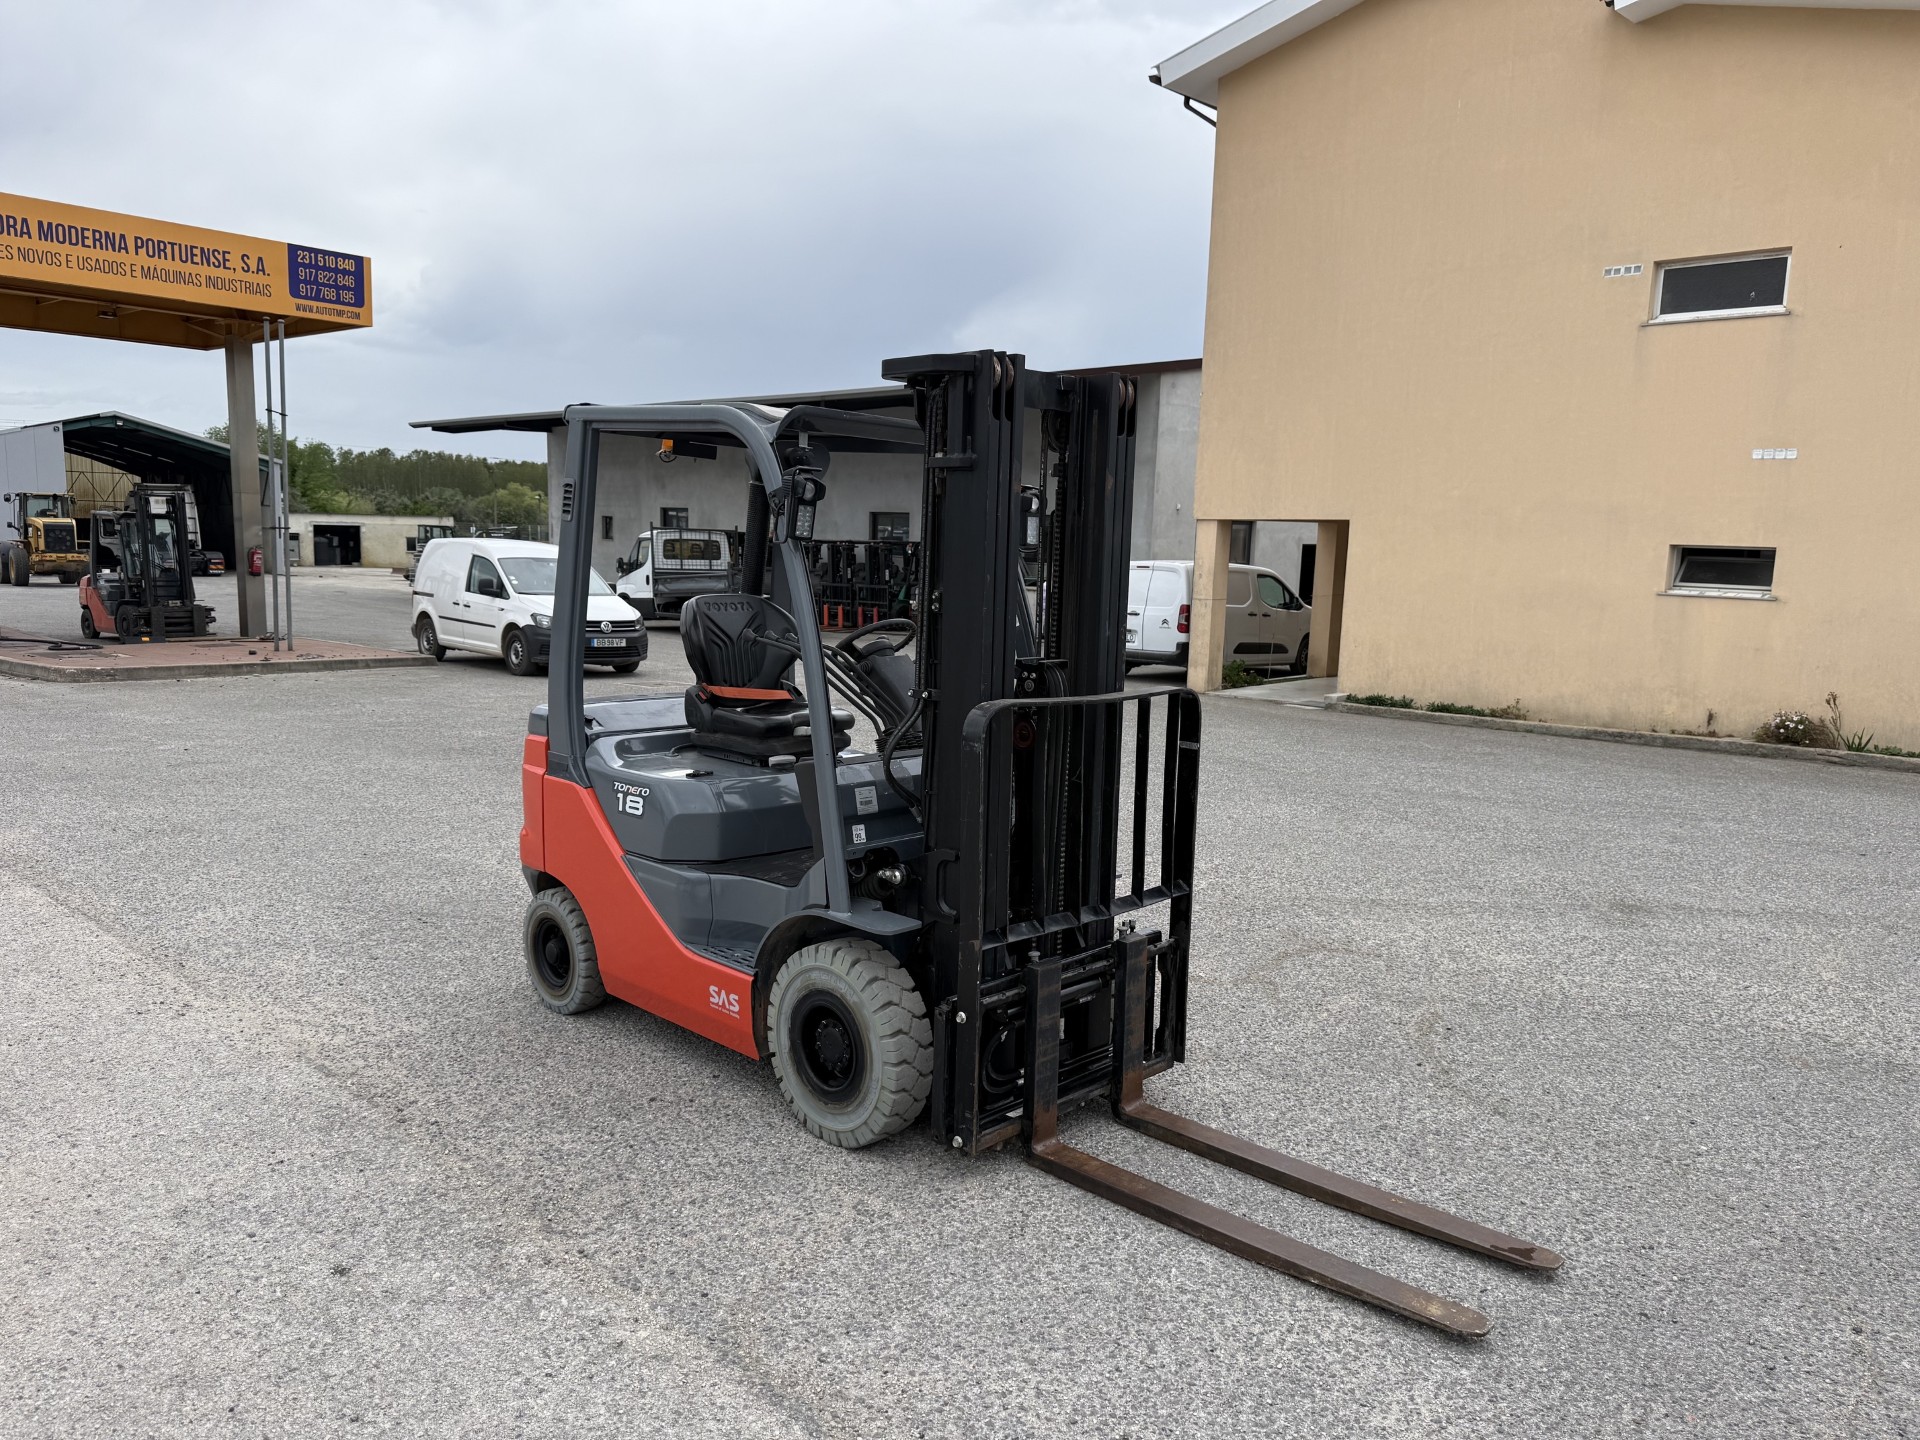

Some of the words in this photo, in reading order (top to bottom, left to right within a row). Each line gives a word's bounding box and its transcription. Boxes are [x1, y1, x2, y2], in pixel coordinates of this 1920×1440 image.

[37, 219, 129, 255] MODERNA
[134, 235, 236, 274] PORTUENSE,
[241, 253, 271, 277] S.A.
[17, 246, 62, 267] NOVOS
[66, 253, 73, 269] E
[77, 255, 127, 277] USADOS
[130, 263, 137, 278] E
[140, 264, 202, 288] MÁQUINAS
[205, 274, 272, 298] INDUSTRIAIS
[297, 250, 315, 264] 231
[318, 254, 336, 268] 510
[337, 257, 355, 272] 840
[298, 267, 316, 281] 917
[318, 270, 336, 285] 822
[337, 274, 355, 288] 846
[300, 283, 317, 297] 917
[318, 286, 337, 300] 768
[339, 290, 355, 303] 195
[294, 302, 361, 320] WWW.AUTOTMP.COM
[704, 601, 754, 612] TOYOTA
[616, 792, 644, 816] 18
[709, 985, 740, 1012] SAS
